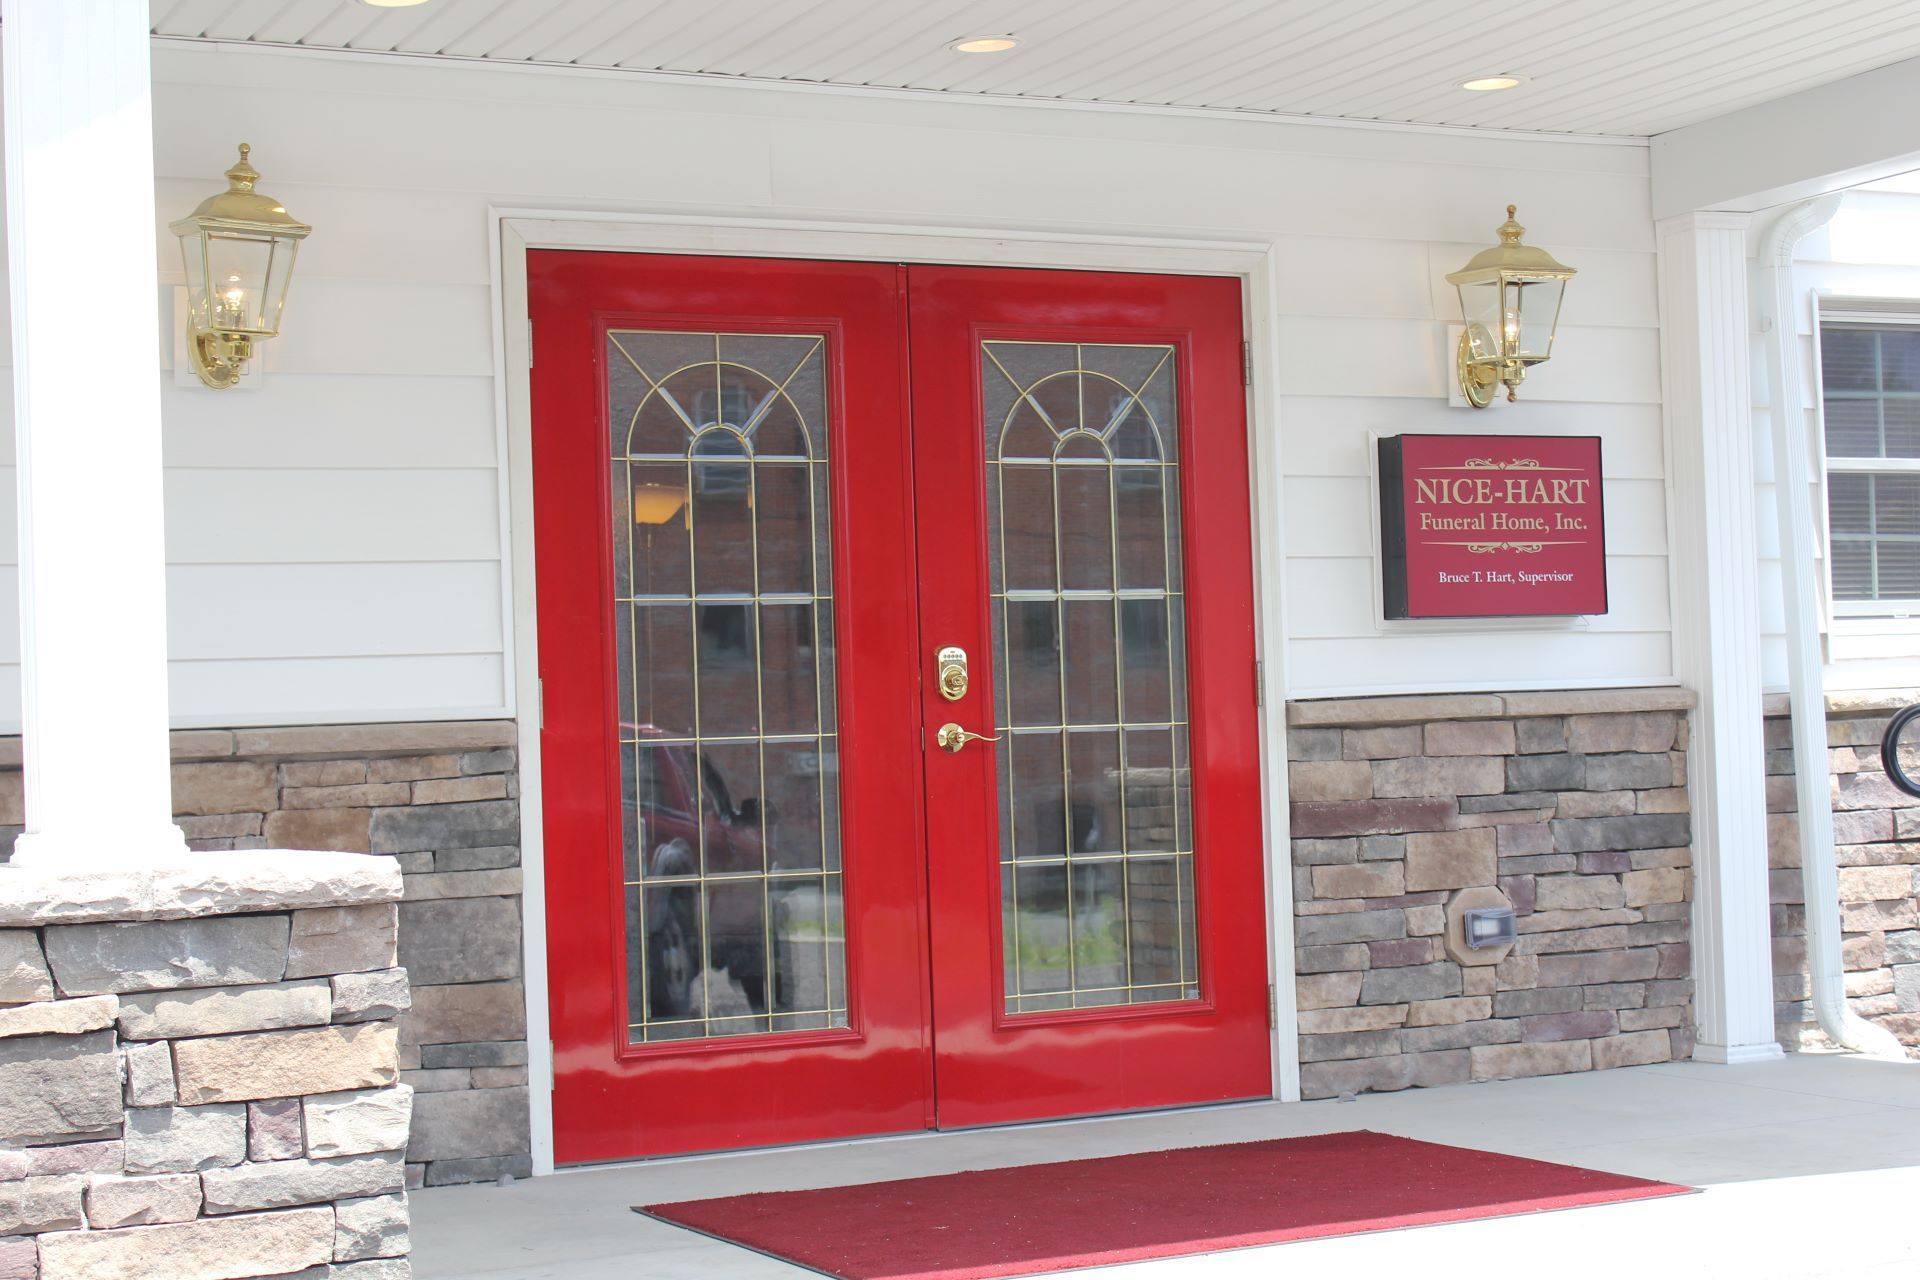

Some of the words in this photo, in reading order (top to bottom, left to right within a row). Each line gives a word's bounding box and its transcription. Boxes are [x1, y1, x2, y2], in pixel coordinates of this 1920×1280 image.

[1414, 478, 1590, 505] NICE-HART
[1420, 512, 1486, 531] Funeral
[1491, 512, 1550, 533] Home,
[1555, 512, 1588, 530] Inc.
[1439, 571, 1470, 583] Bruce
[1472, 571, 1484, 583] T.
[1486, 571, 1516, 585] Hart,
[1518, 570, 1574, 586] Supervisor
